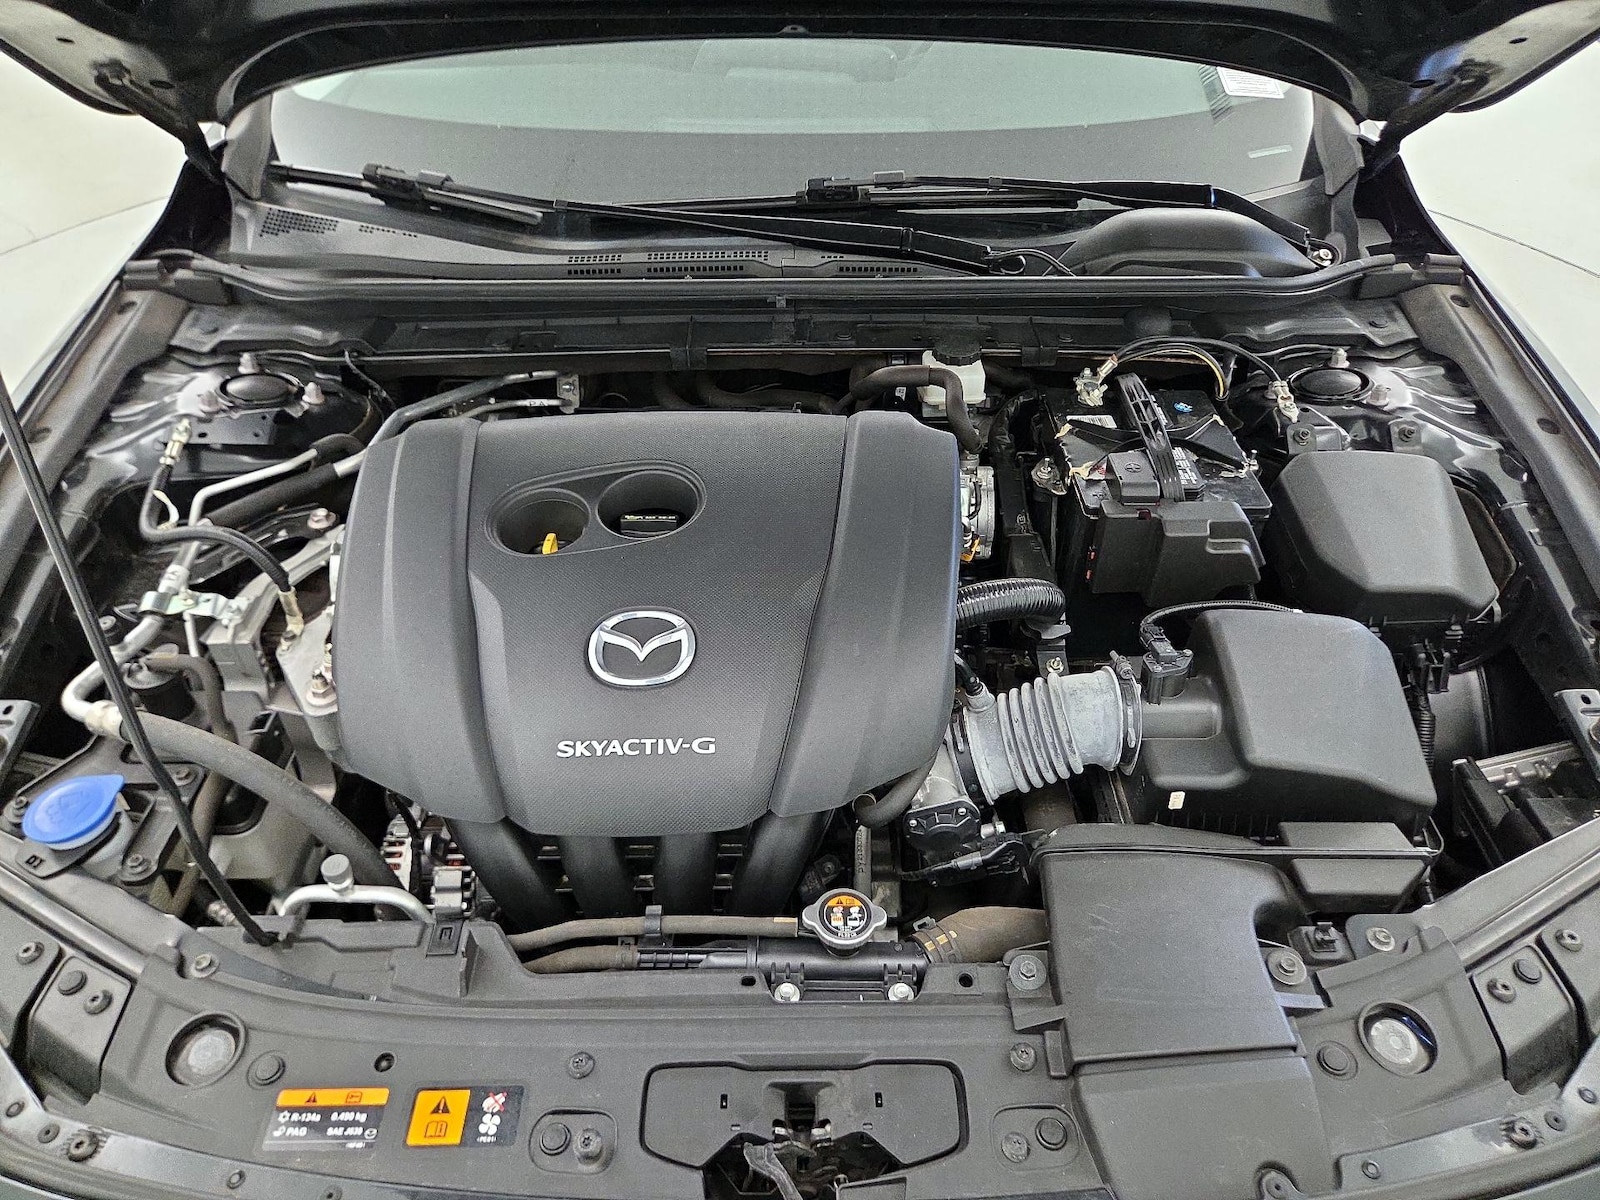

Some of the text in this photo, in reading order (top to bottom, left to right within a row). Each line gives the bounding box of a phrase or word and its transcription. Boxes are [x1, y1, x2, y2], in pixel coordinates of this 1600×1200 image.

[556, 737, 716, 758] SKYACTIV-G
[290, 1112, 321, 1122] R-134a
[285, 1126, 308, 1137] PAG
